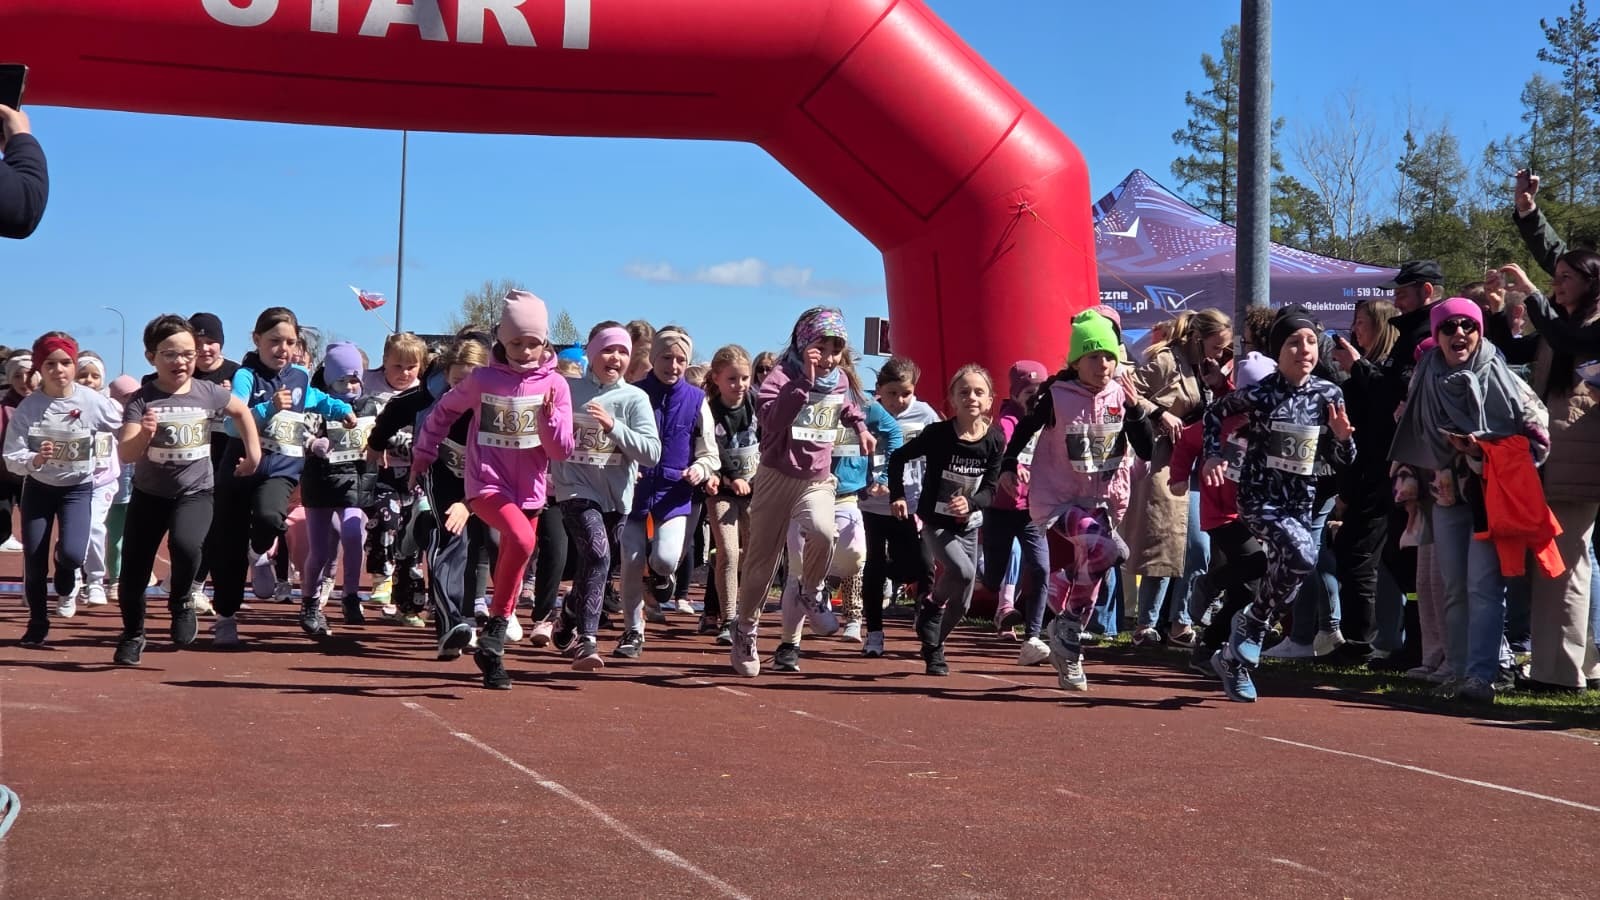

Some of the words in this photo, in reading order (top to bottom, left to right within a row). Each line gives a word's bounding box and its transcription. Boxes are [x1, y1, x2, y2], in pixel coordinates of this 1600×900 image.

[1357, 287, 1371, 297] 519
[492, 409, 536, 433] 432
[803, 405, 834, 427] 361
[164, 423, 204, 447] 303
